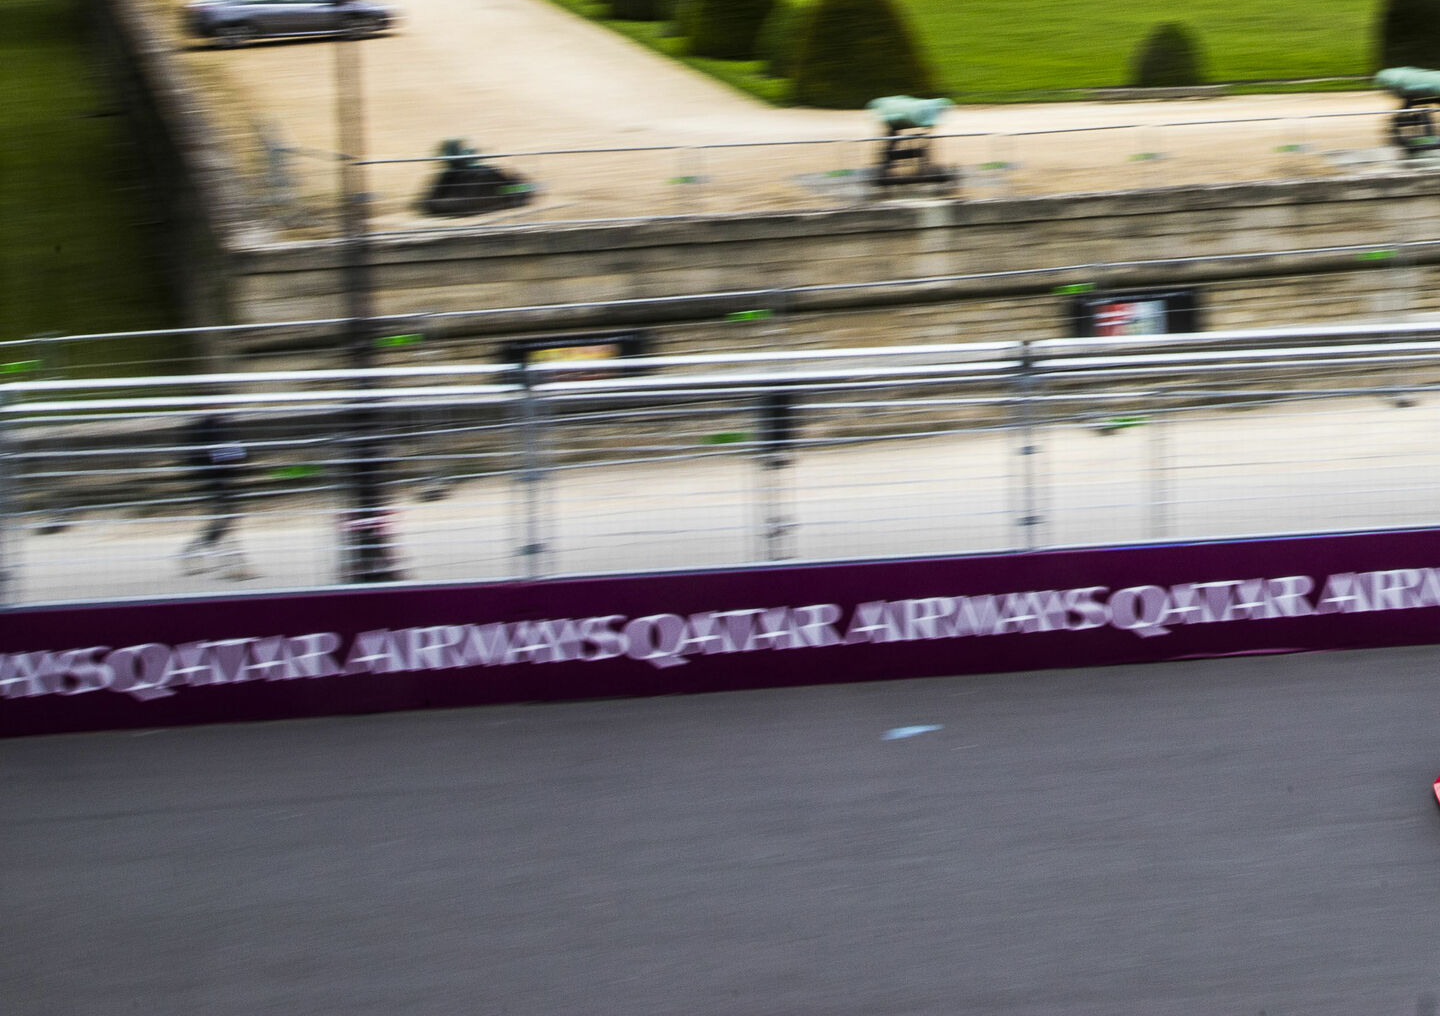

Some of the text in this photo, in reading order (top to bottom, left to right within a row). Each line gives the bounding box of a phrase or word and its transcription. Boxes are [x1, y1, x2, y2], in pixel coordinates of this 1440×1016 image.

[108, 632, 345, 702] QATAR
[342, 615, 630, 676] AIRWAYS
[624, 604, 845, 669] QATAR
[842, 586, 1111, 645] AIRWAYS
[1108, 576, 1317, 638] QATAR
